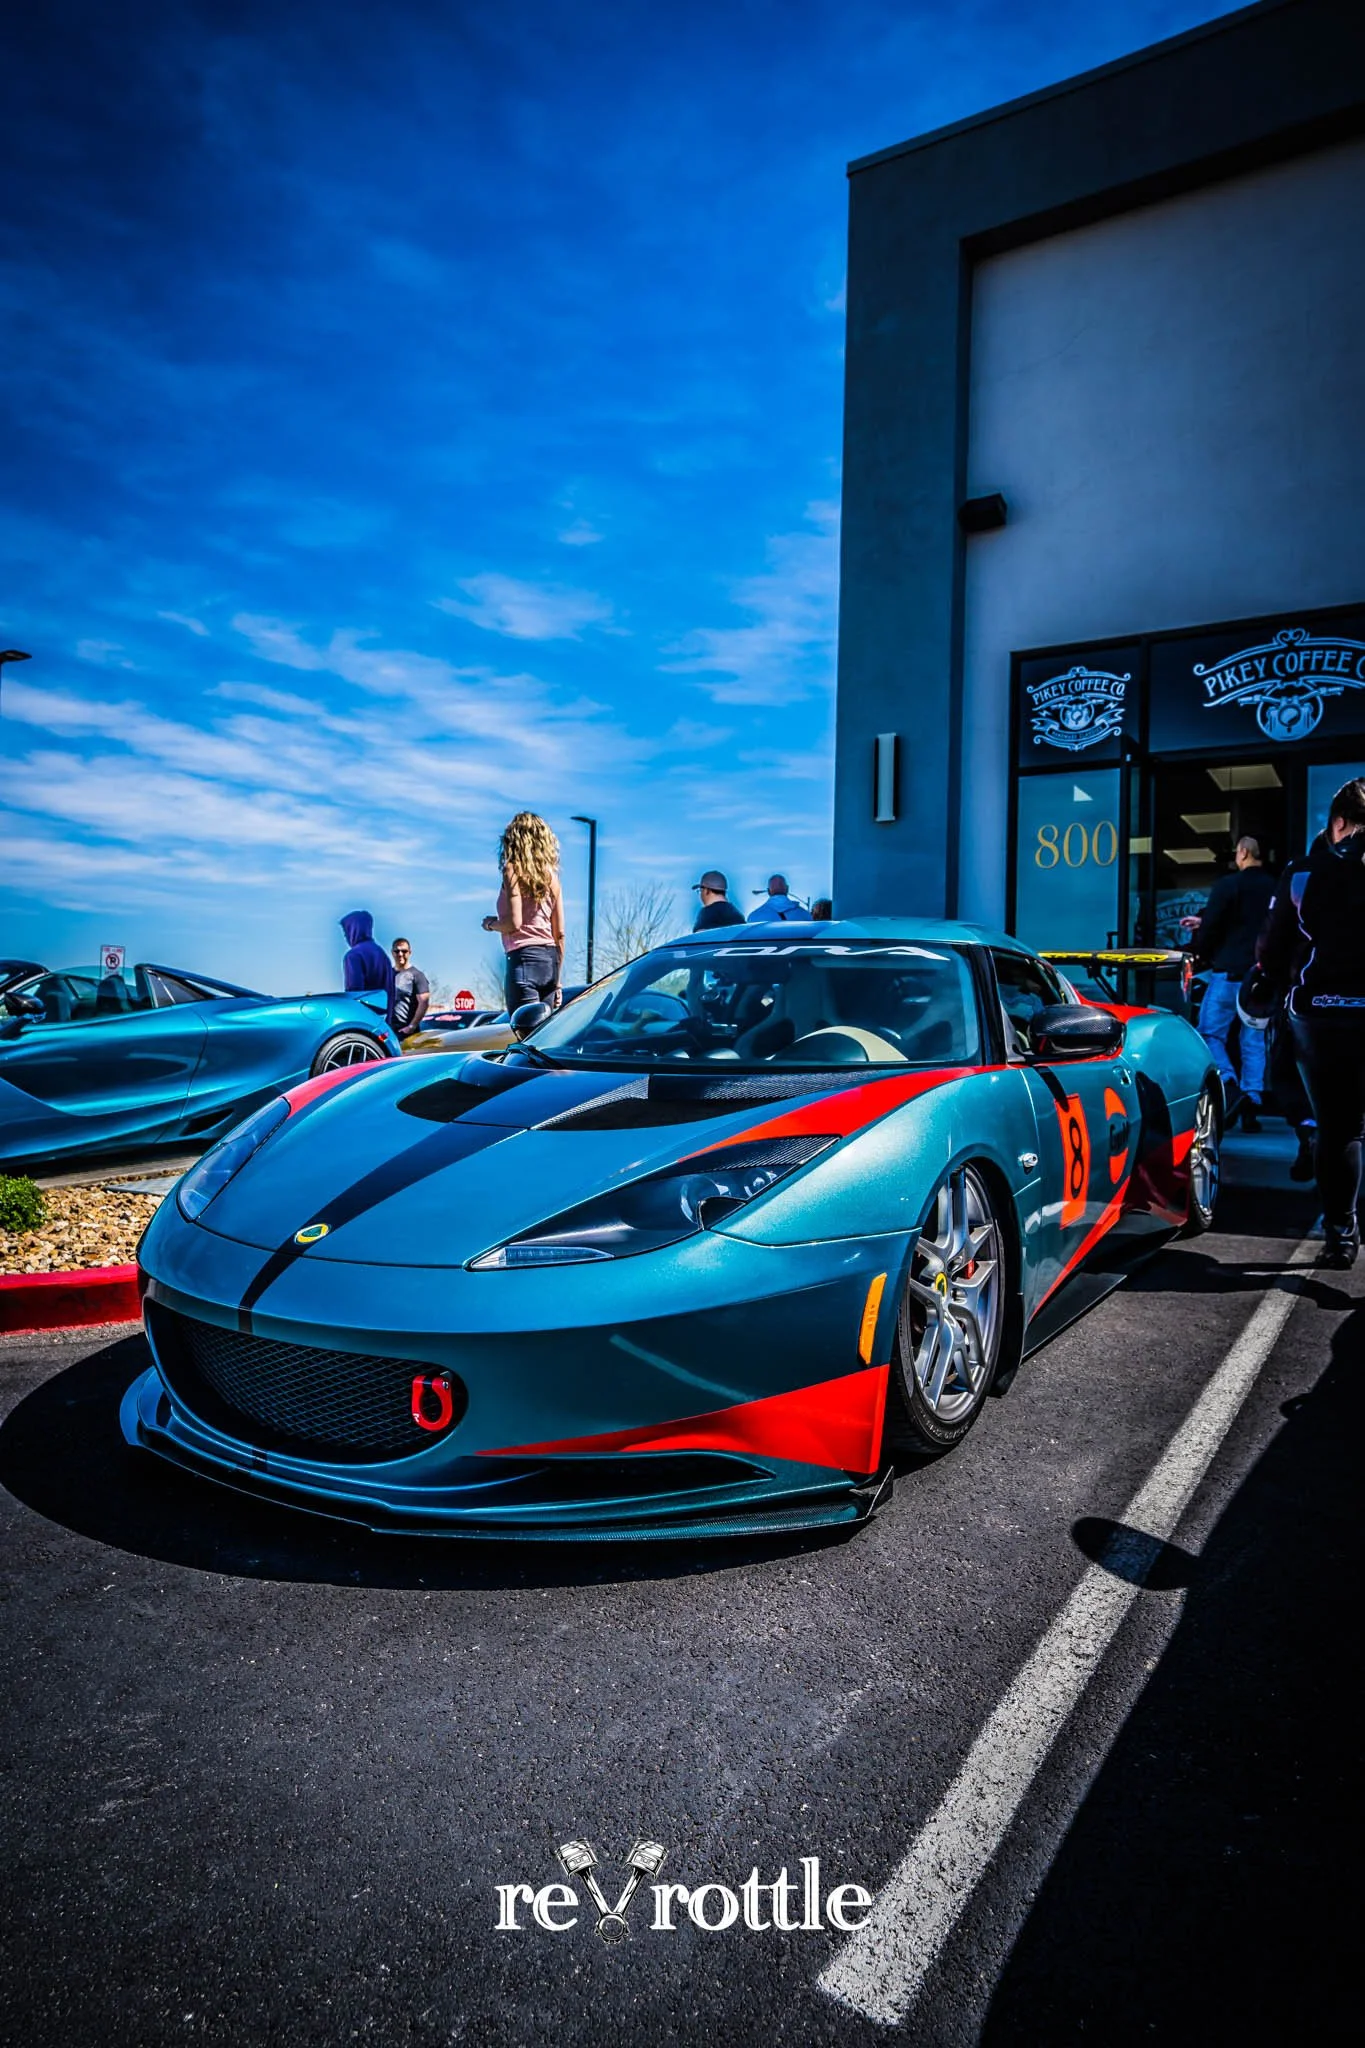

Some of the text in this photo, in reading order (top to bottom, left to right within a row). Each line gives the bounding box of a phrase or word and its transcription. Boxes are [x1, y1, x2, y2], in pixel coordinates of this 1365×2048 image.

[1032, 682, 1066, 705] PIKEY
[1068, 678, 1109, 694] COFFEE
[1203, 657, 1267, 697] PIKEY
[1272, 650, 1352, 677] COFFEE
[1035, 820, 1118, 869] 800
[455, 997, 475, 1009] STOP
[1069, 1116, 1084, 1199] 8
